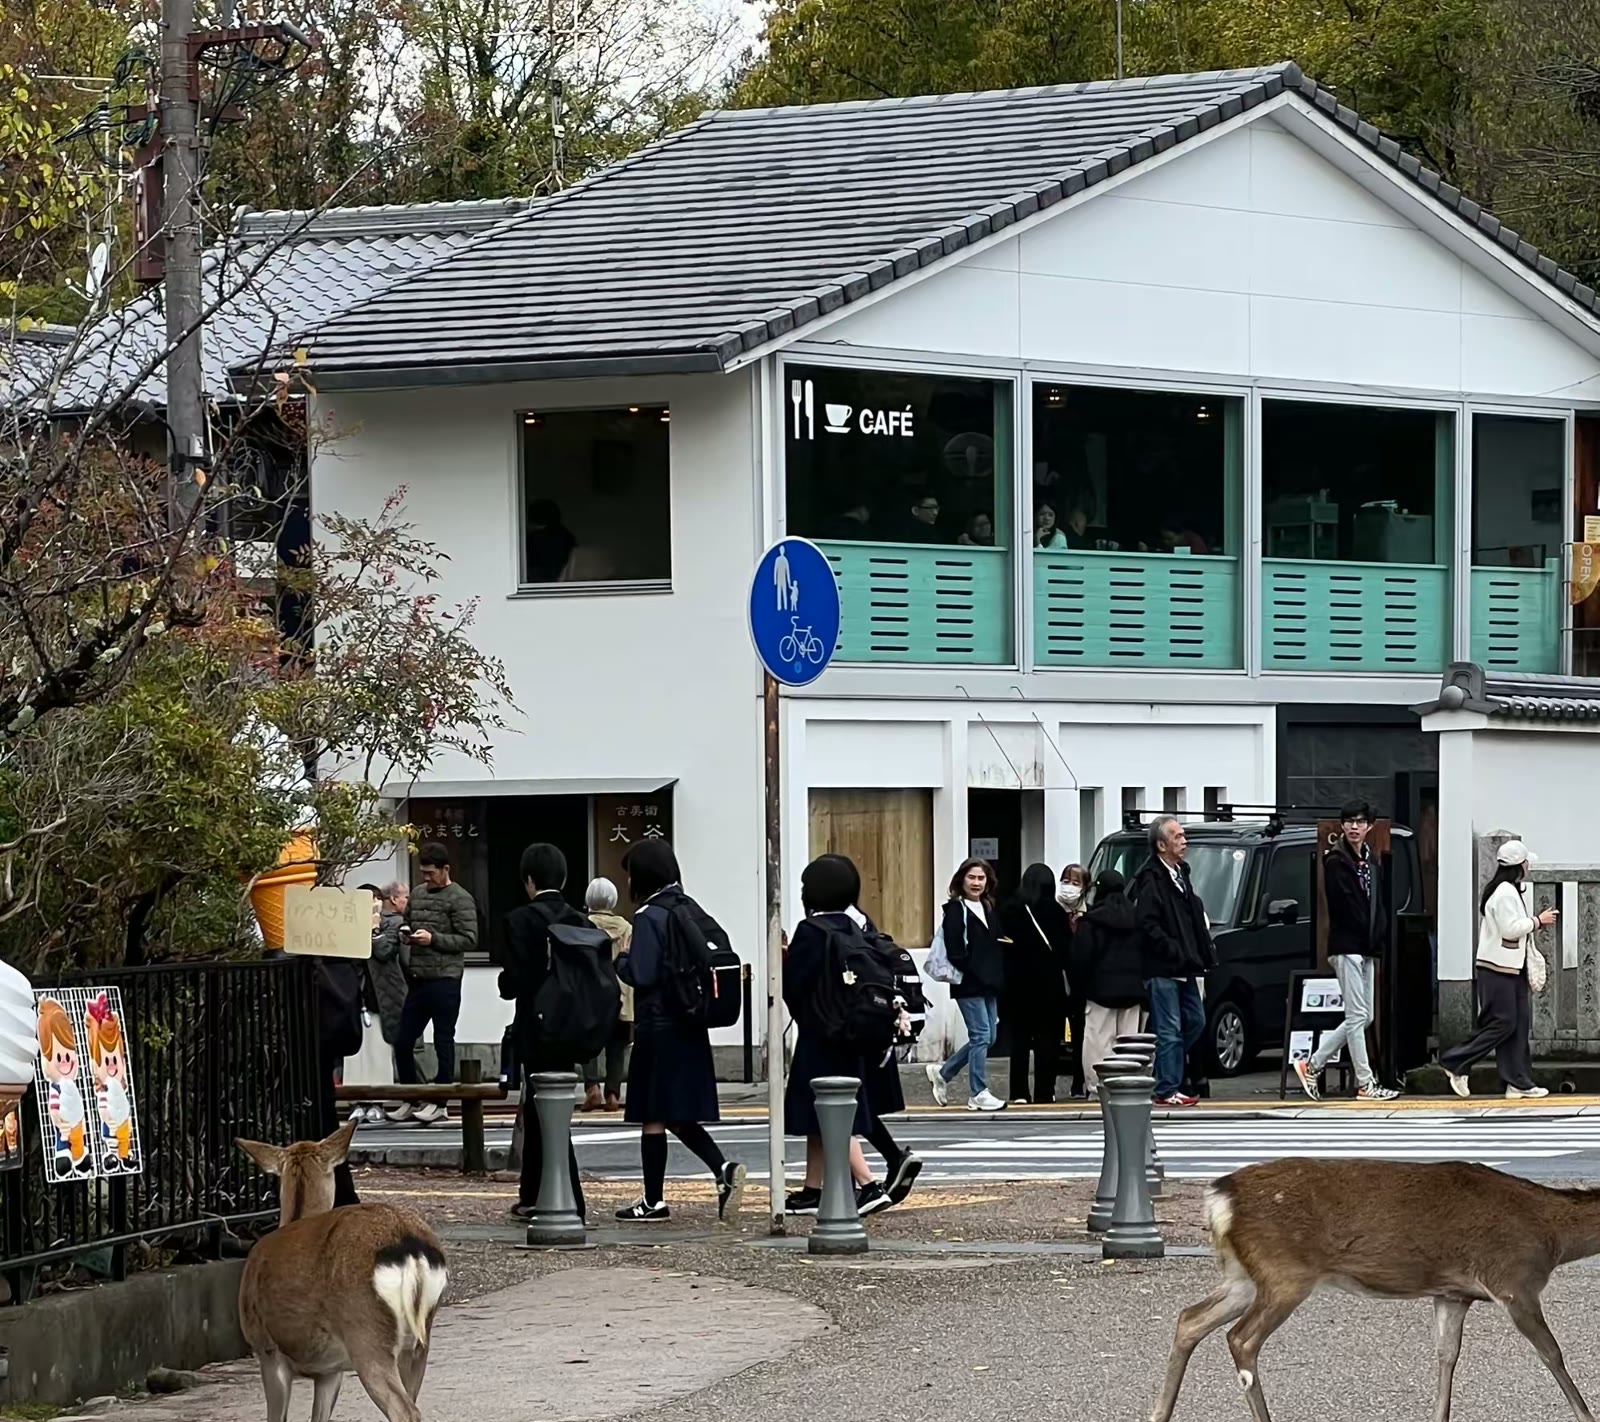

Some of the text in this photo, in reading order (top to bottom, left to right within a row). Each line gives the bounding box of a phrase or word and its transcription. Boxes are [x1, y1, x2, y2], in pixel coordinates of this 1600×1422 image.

[859, 404, 914, 437] CAFÉ
[1580, 545, 1593, 584] OPEN
[615, 805, 659, 817] 古美術
[417, 823, 479, 838] やまもと
[632, 1206, 645, 1217] N
